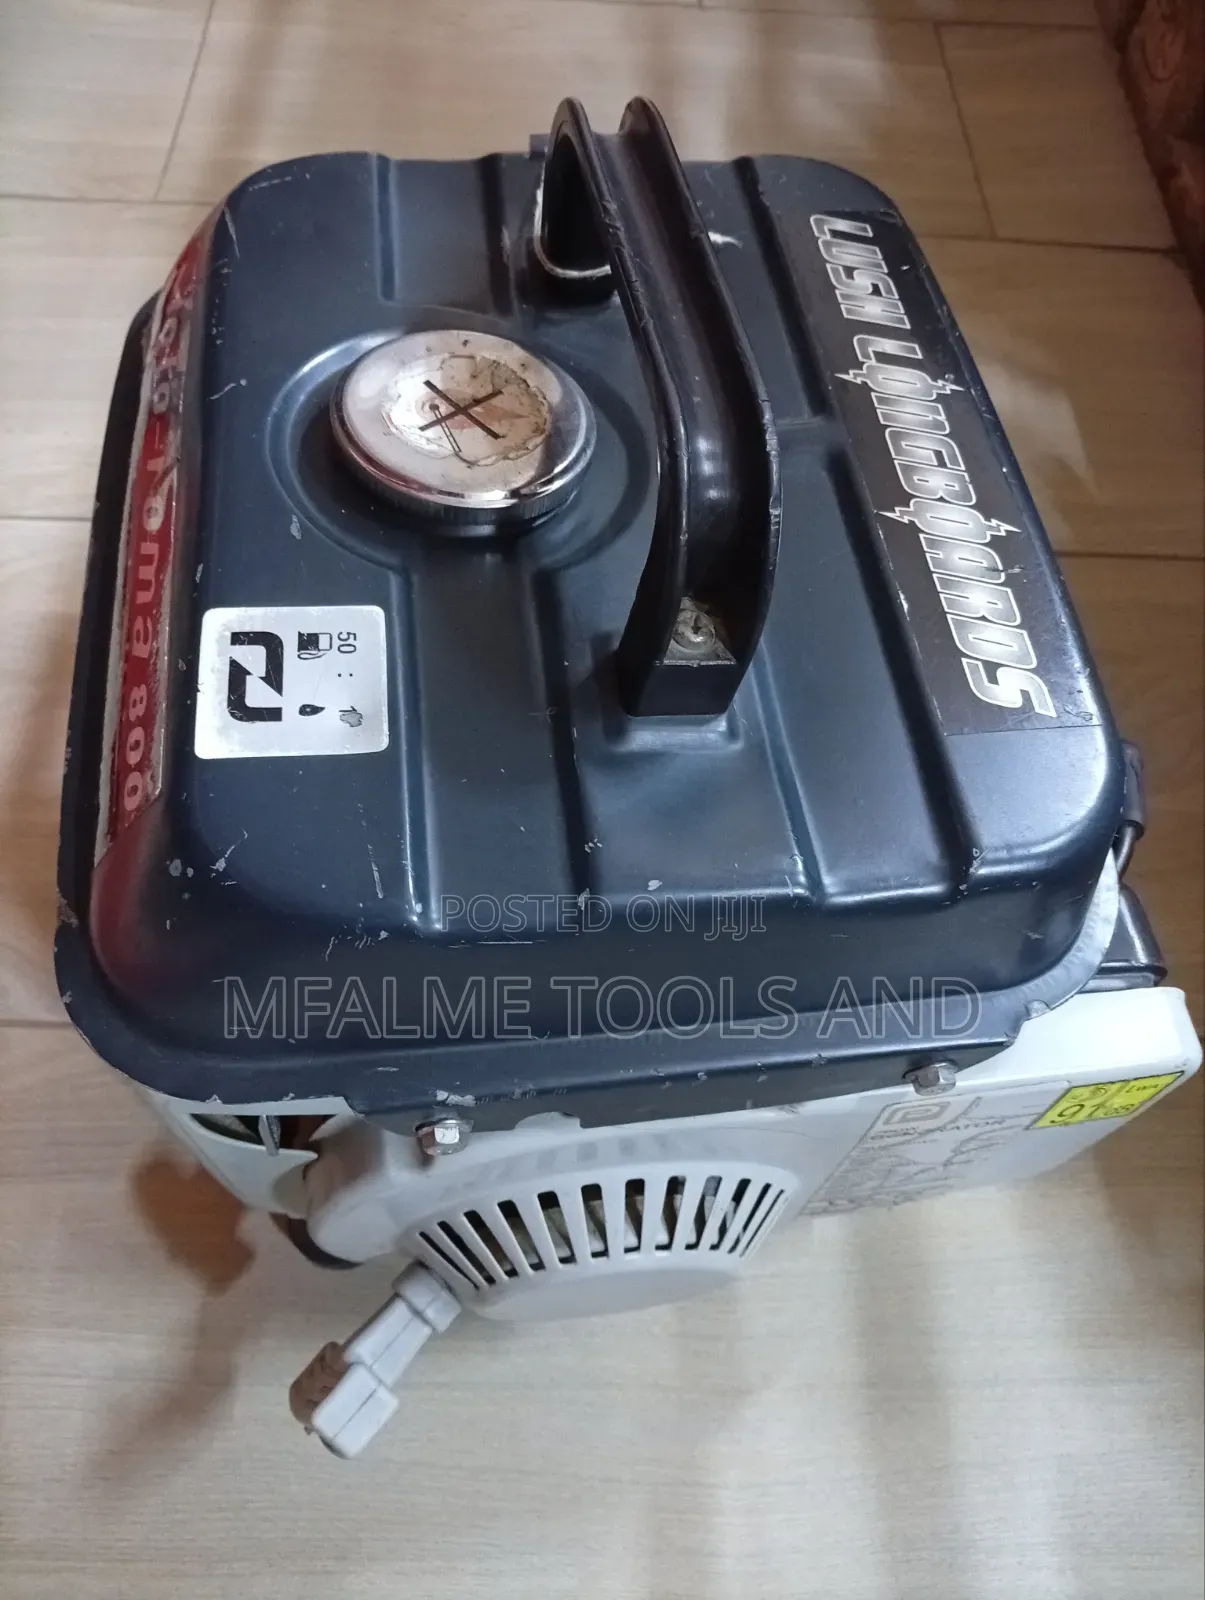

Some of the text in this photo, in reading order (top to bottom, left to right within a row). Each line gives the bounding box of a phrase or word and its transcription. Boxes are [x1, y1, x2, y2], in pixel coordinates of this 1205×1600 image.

[810, 214, 1057, 718] LUSH LONGBOARDS
[337, 631, 357, 655] 50
[123, 683, 147, 811] 800
